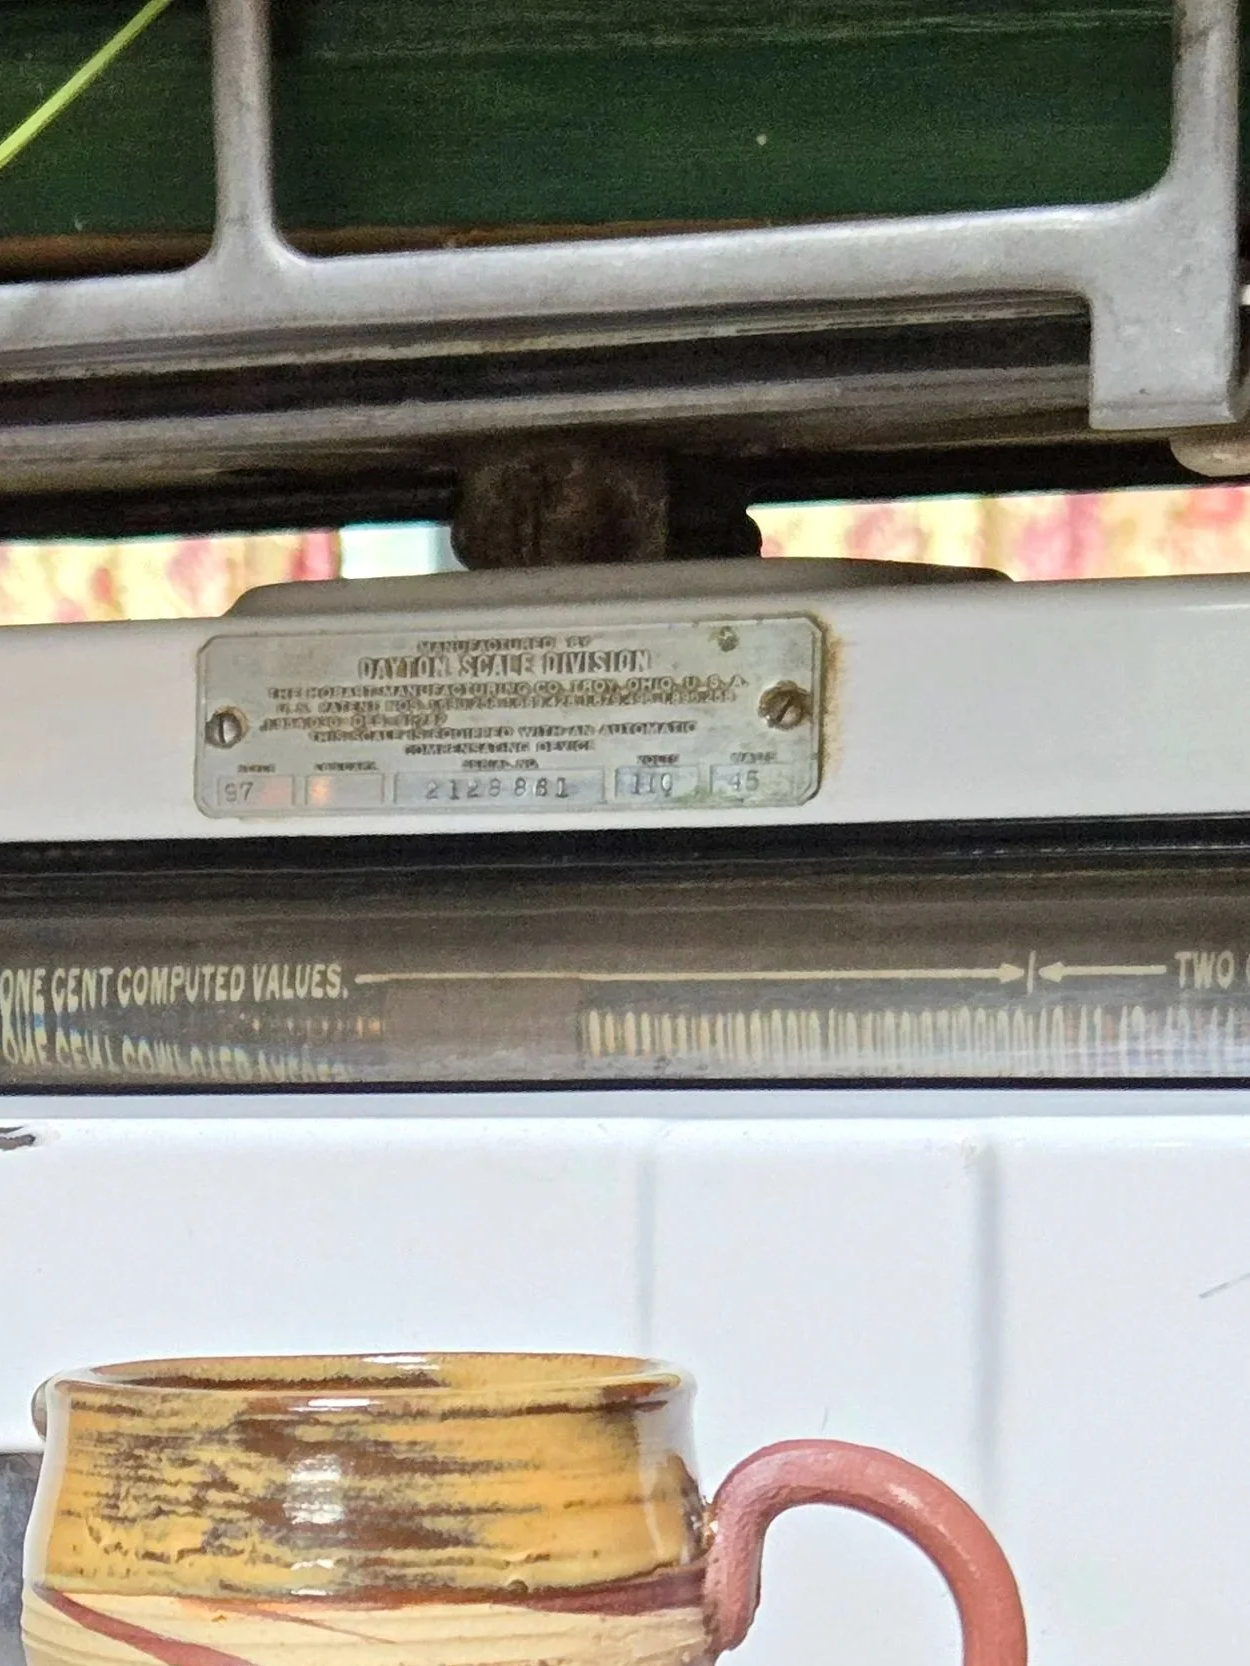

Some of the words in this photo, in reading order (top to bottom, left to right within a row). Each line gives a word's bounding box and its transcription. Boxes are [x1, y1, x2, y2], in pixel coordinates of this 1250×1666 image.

[358, 655, 452, 679] DAYTON
[456, 652, 534, 677] SCALE
[542, 649, 652, 676] DIVISION
[381, 681, 530, 698] MANUFACTURING
[599, 720, 698, 736] AUTOMATIC
[1174, 950, 1235, 989] TWO
[0, 968, 45, 1011] ONE
[52, 967, 113, 1014] CENT
[117, 964, 246, 1006] COMPUTED
